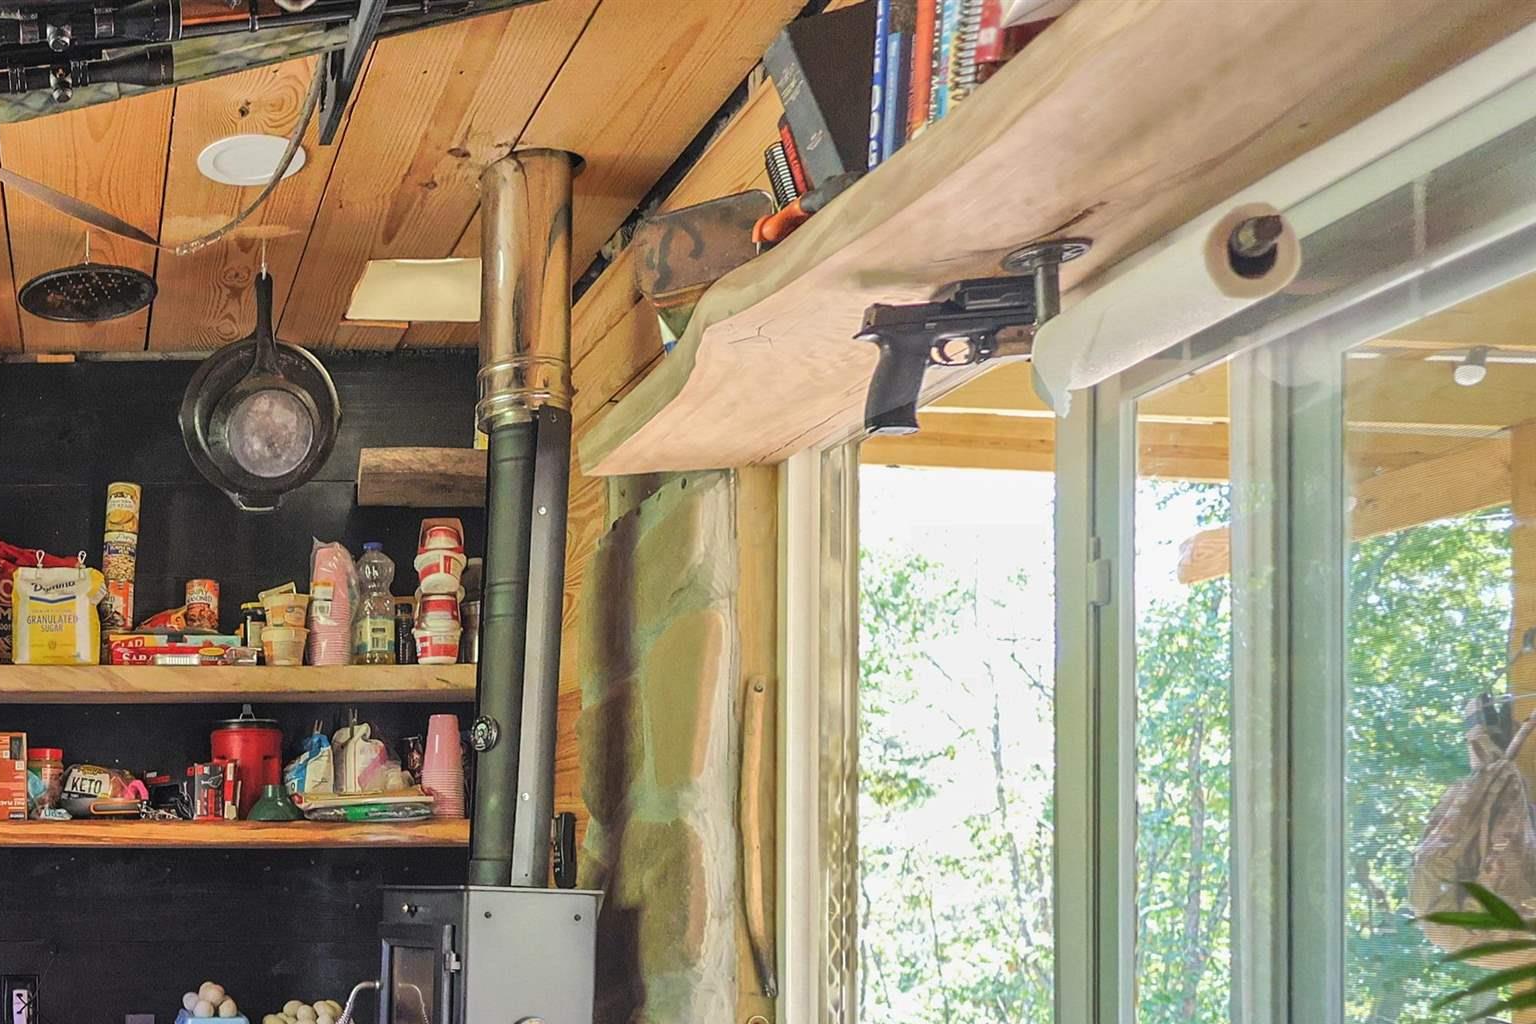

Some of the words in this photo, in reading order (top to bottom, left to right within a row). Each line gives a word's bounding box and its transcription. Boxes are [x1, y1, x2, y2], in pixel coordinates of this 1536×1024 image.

[27, 615, 79, 625] GRANULATED
[40, 623, 64, 633] SUGAR
[71, 776, 103, 794] KETO
